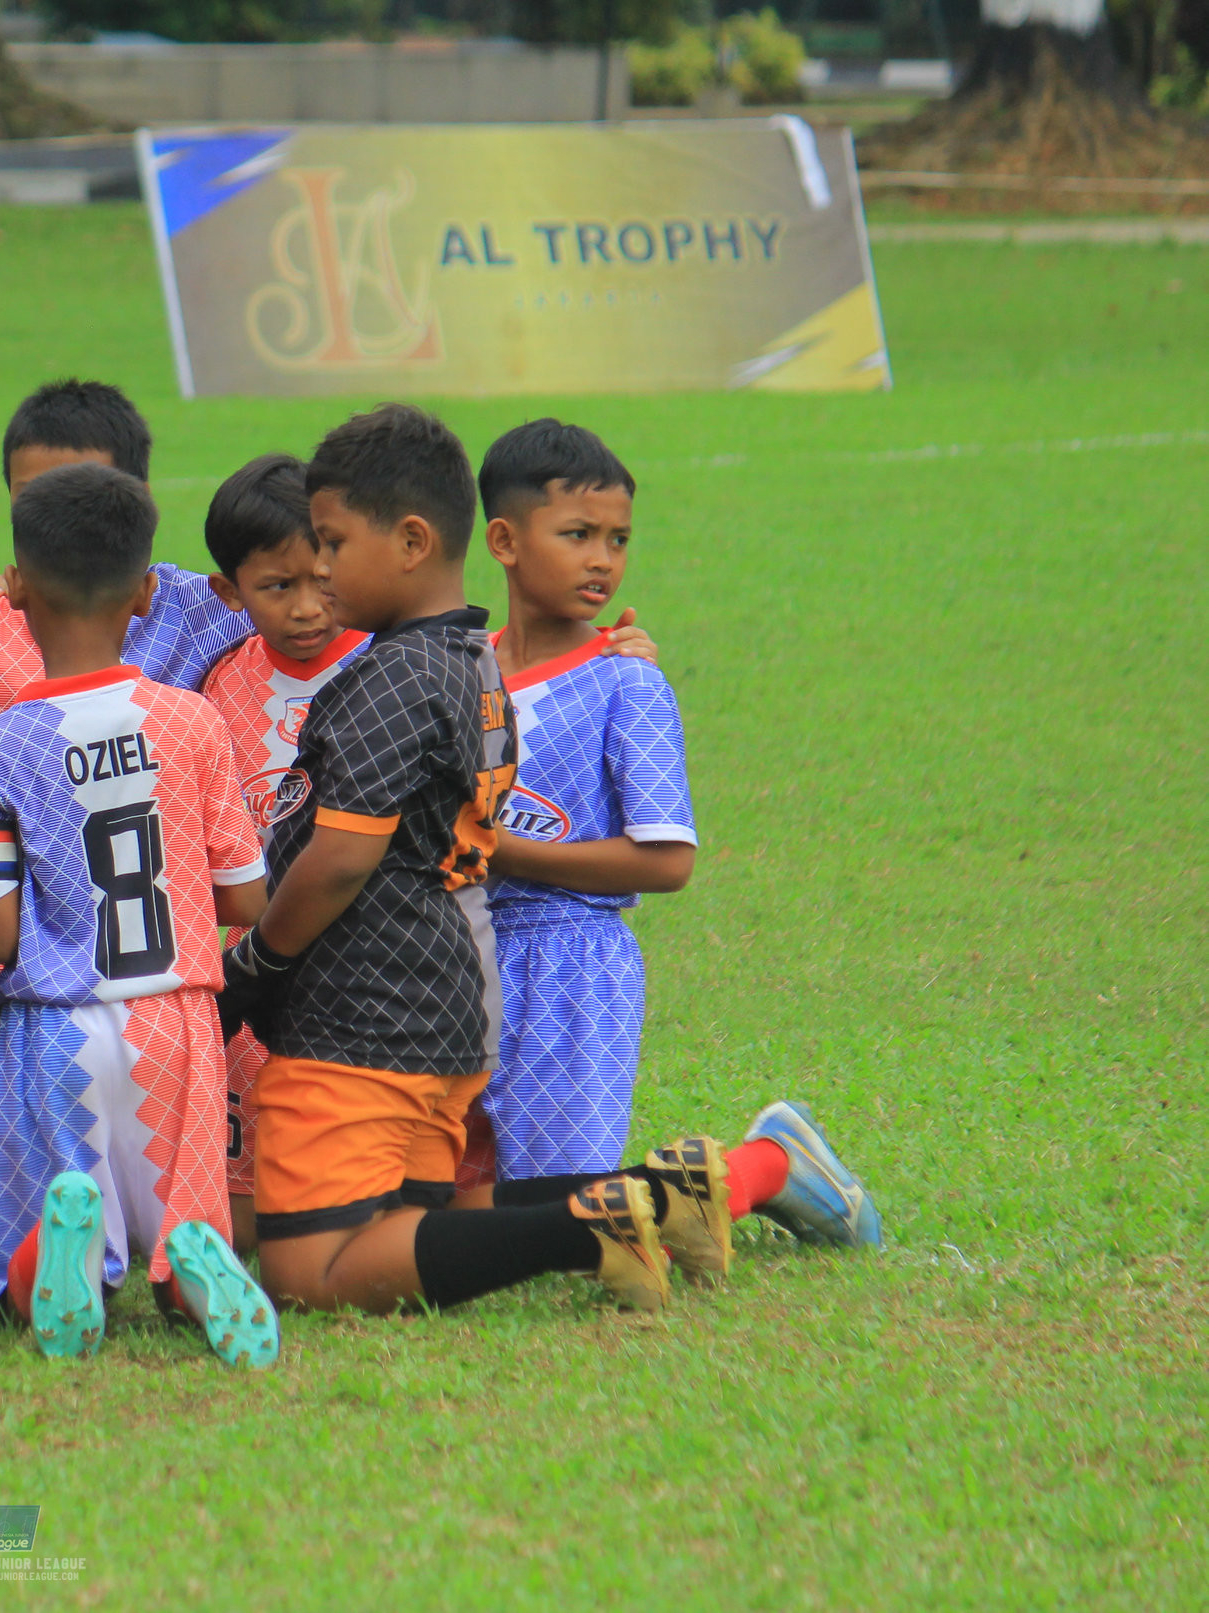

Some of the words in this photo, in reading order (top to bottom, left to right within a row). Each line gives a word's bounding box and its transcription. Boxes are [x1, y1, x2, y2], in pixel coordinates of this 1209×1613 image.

[440, 223, 514, 267] AL
[532, 217, 779, 264] TROPHY
[65, 732, 159, 786] OZIEL
[82, 799, 178, 981] 8
